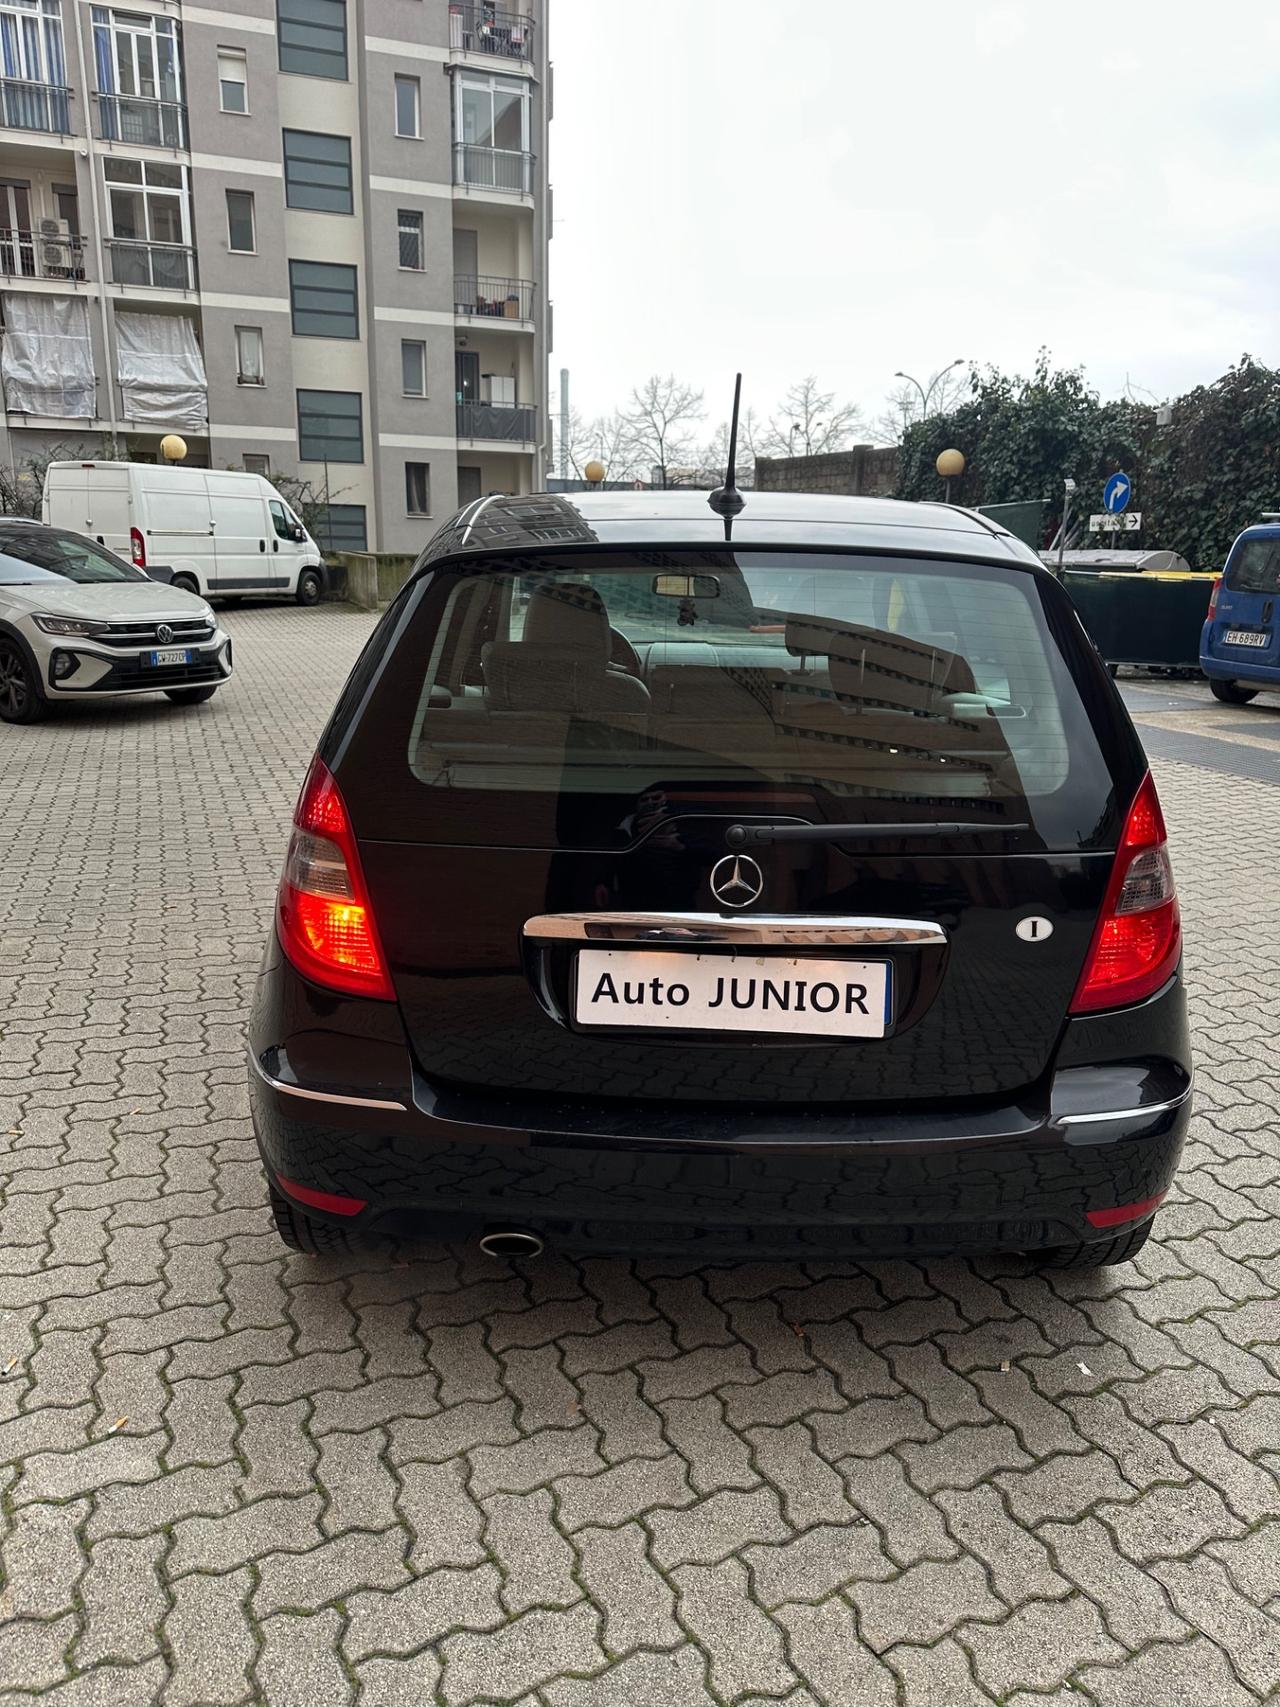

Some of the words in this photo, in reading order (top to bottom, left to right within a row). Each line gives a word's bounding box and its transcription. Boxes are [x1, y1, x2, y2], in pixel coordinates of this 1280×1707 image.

[1031, 920, 1038, 938] I
[591, 972, 690, 1007] Auto
[708, 977, 870, 1015] JUNIOR
